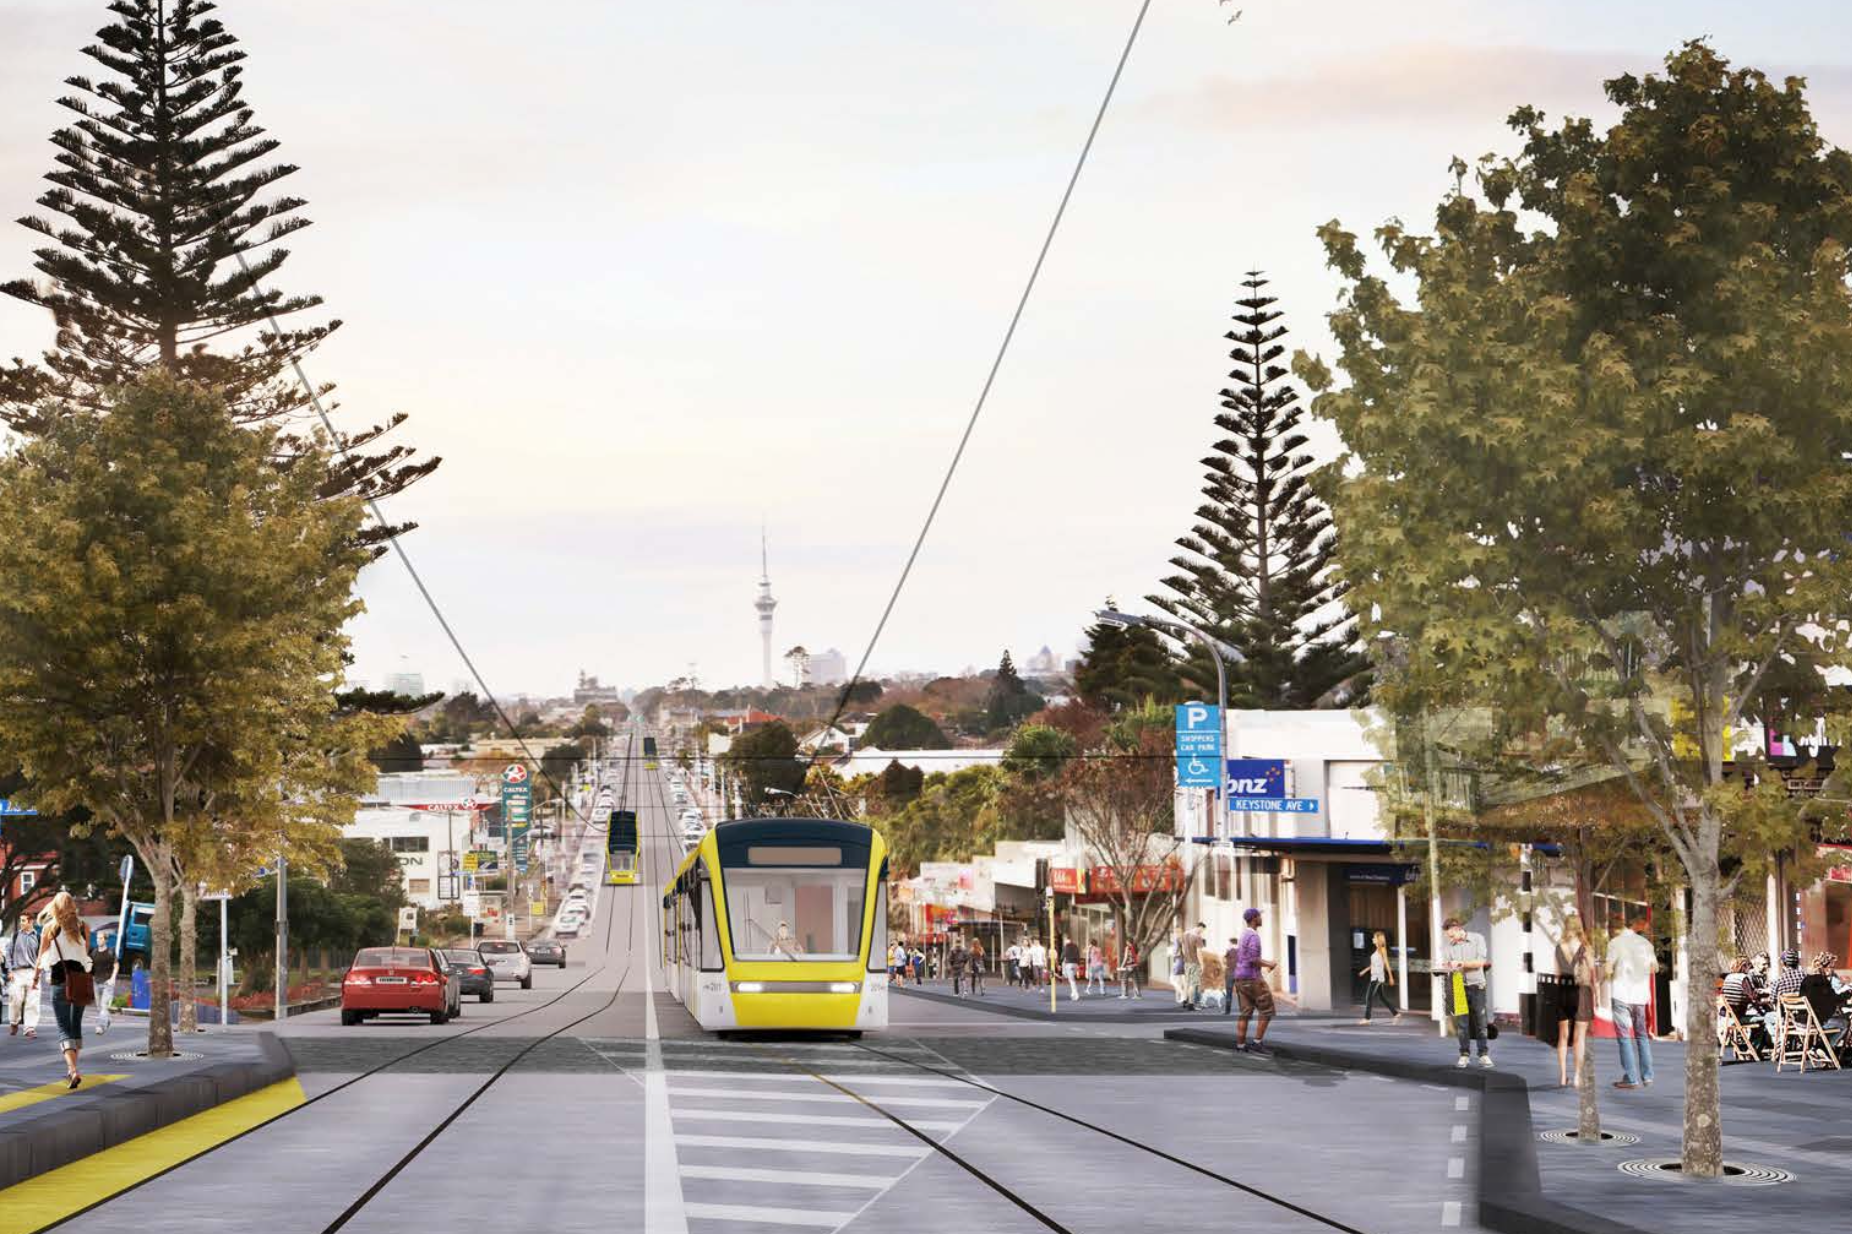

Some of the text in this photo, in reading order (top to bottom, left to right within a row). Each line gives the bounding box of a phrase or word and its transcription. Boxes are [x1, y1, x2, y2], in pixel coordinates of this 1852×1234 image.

[1188, 707, 1208, 729] P
[1227, 773, 1268, 794] bnz
[1236, 800, 1303, 811] KEYSTONE AVE
